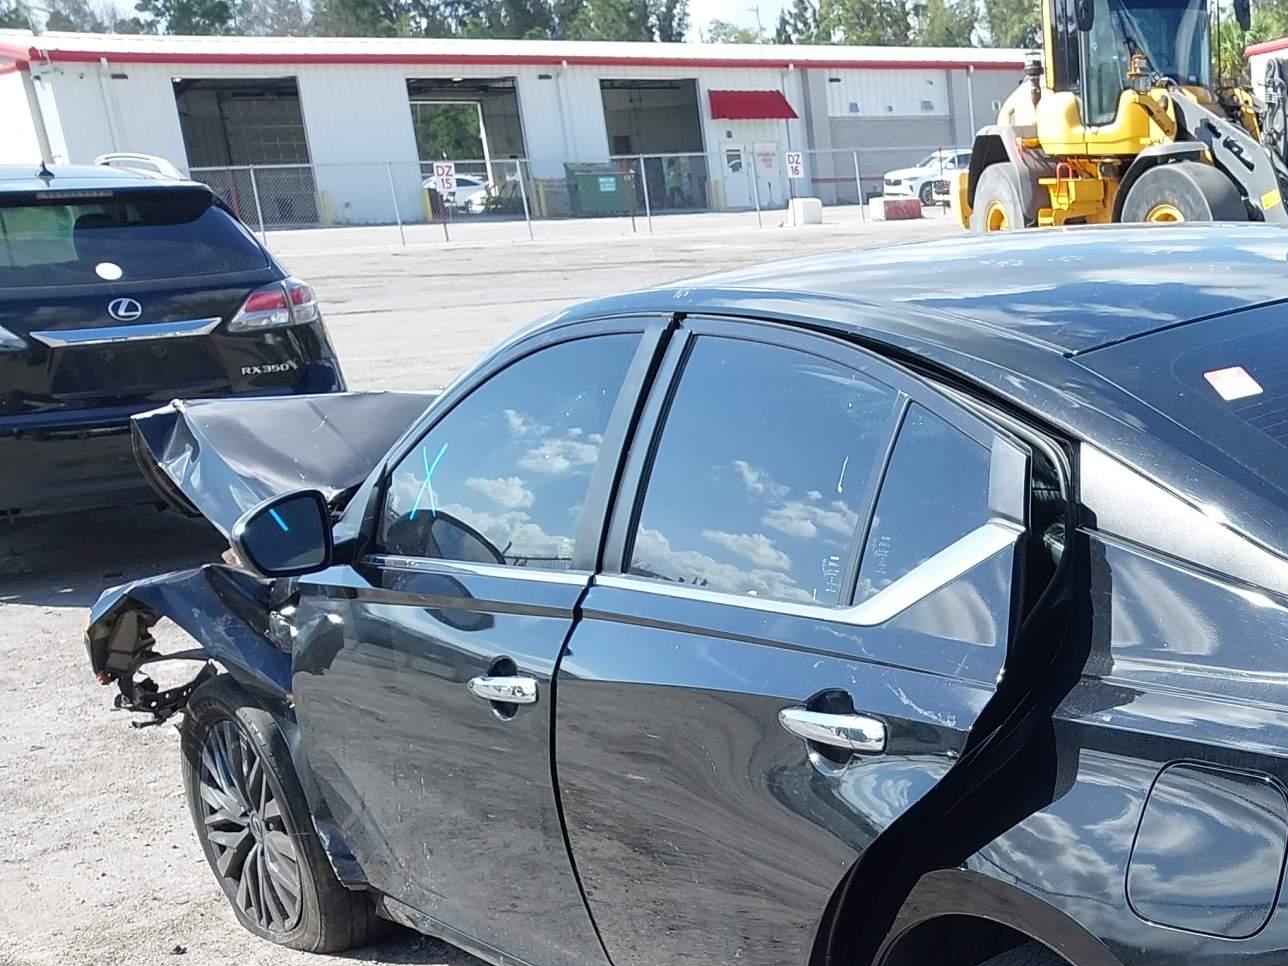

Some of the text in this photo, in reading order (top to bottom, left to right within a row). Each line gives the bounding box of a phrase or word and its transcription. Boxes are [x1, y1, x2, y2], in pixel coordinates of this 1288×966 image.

[787, 153, 801, 165] DZ
[436, 165, 453, 177] DZ
[790, 166, 800, 176] 16
[441, 178, 452, 189] 15
